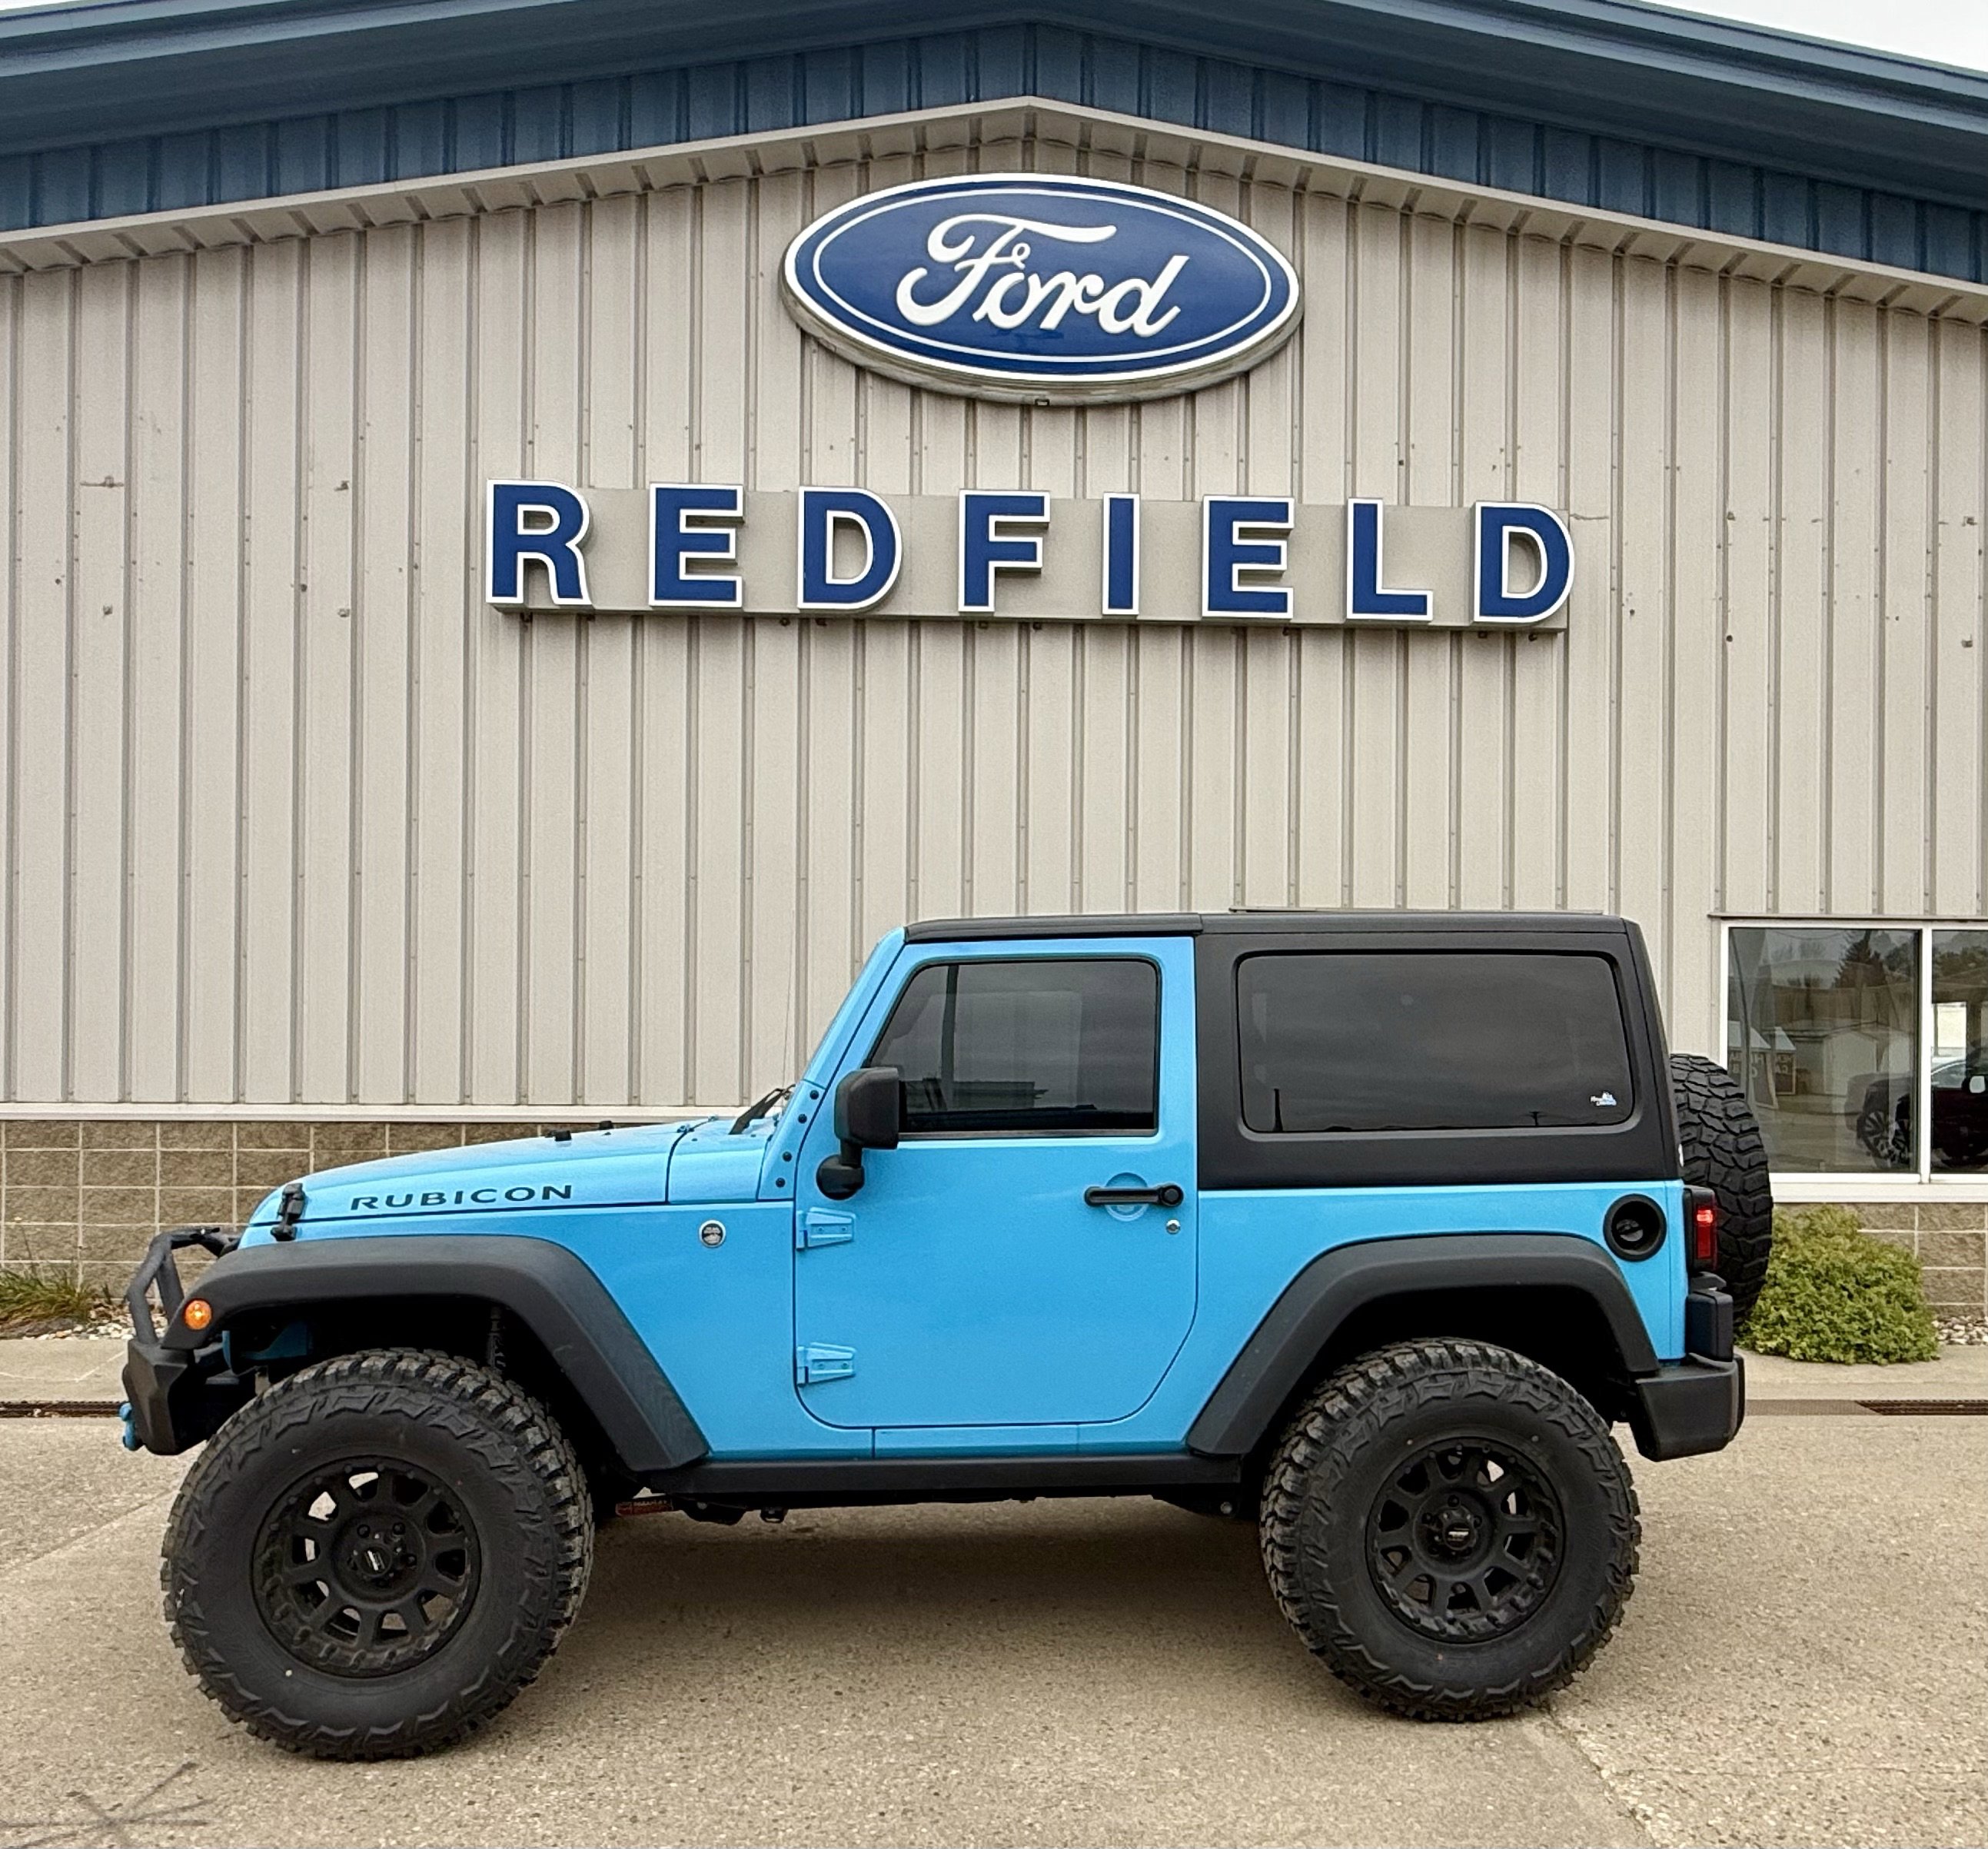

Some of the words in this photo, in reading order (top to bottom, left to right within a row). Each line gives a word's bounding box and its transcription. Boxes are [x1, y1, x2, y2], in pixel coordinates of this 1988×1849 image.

[896, 213, 1189, 337] Ford
[486, 479, 1575, 624] REDFIELD
[350, 1185, 572, 1211] RUBICON
